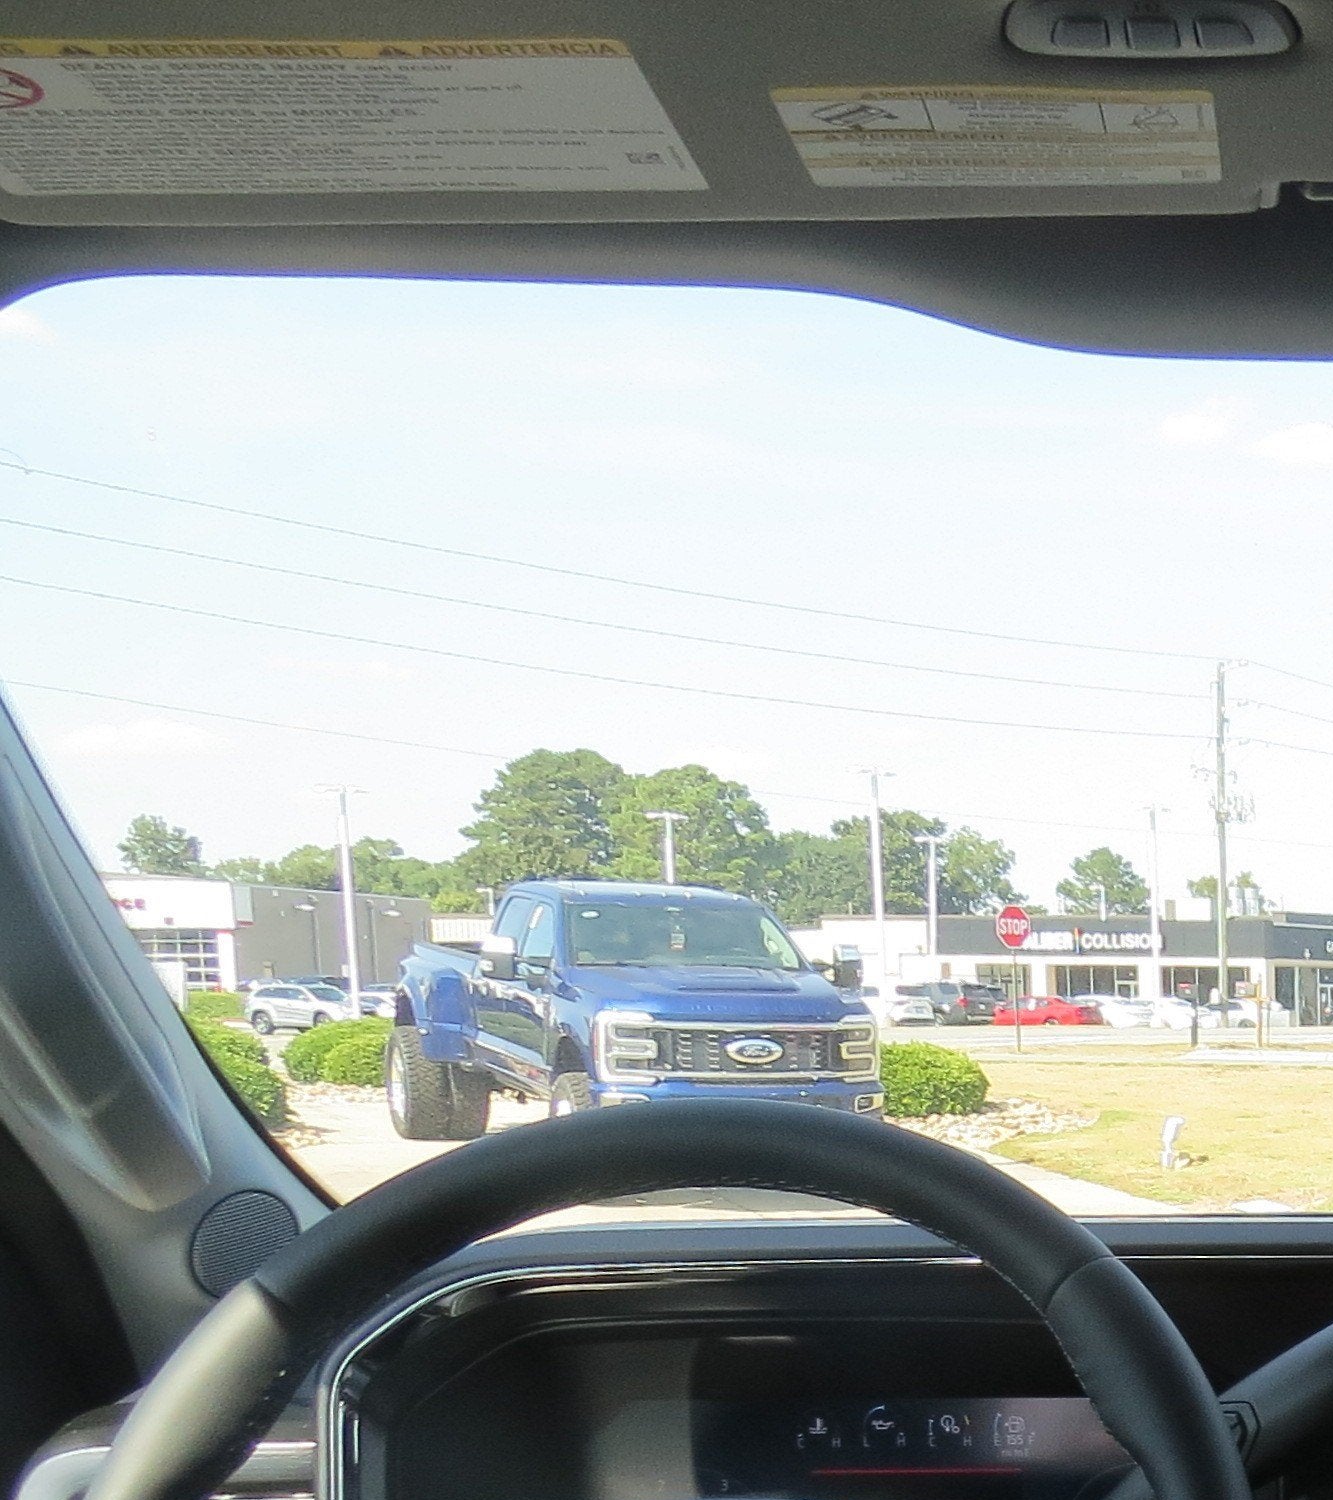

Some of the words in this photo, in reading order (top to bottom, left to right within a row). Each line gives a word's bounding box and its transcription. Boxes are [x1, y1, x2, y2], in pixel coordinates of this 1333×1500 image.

[421, 43, 619, 57] ADVERTENCIA
[1000, 918, 1028, 936] STOP
[1023, 931, 1074, 950] ALIBER
